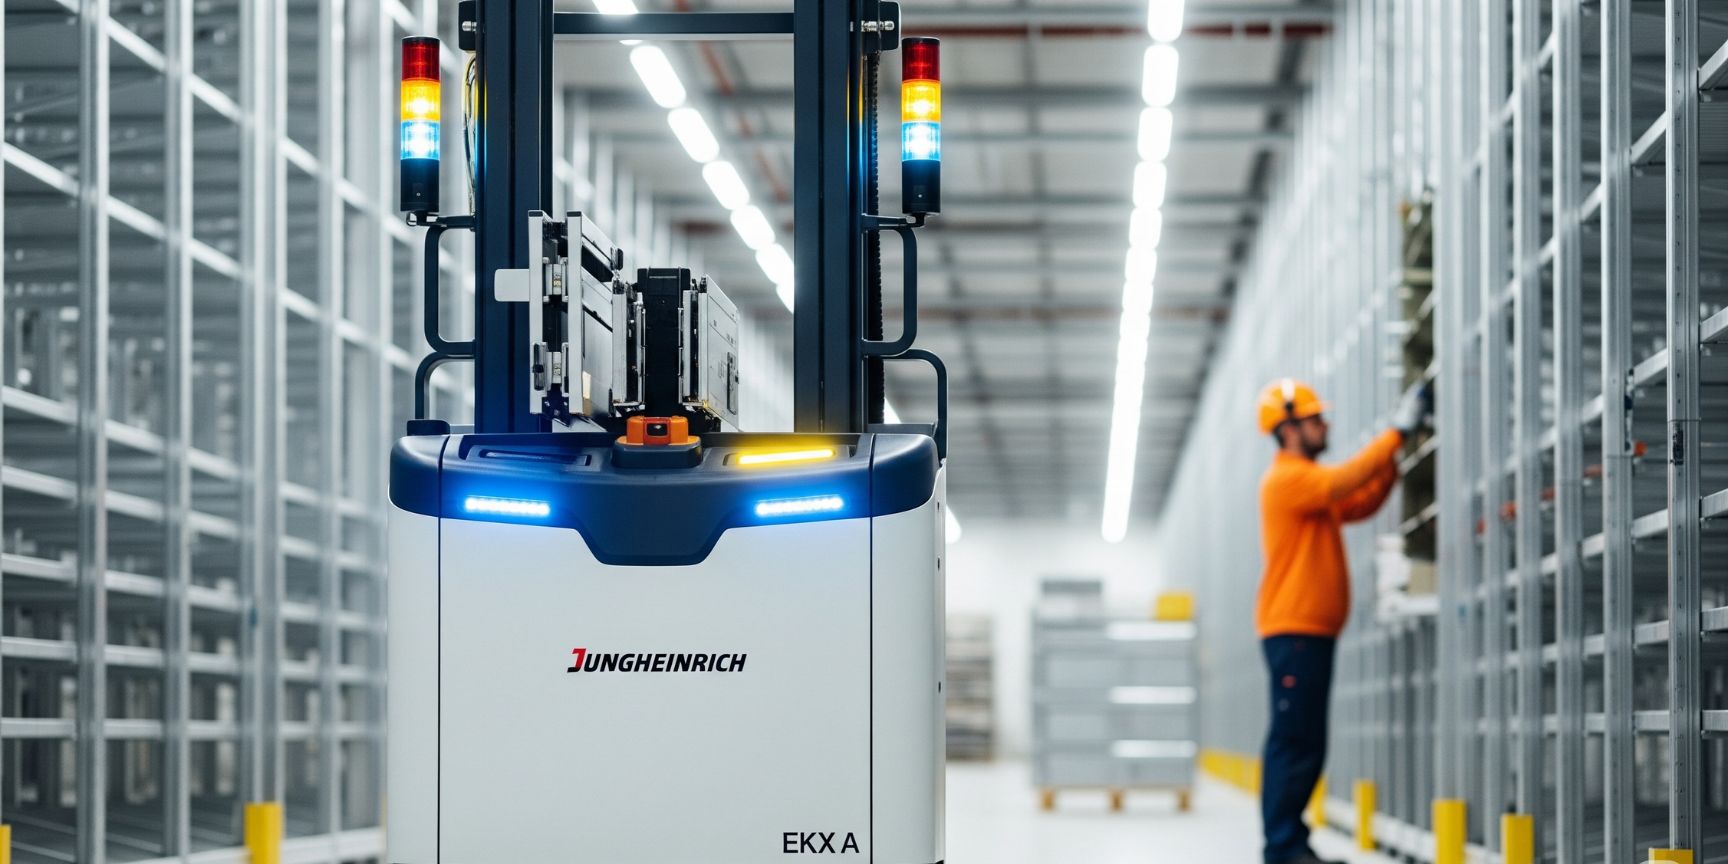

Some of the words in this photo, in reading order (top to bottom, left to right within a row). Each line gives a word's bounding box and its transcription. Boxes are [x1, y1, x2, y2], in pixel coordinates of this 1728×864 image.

[567, 648, 747, 673] JUNGHEINRICH
[783, 832, 836, 853] EKX
[841, 832, 860, 853] A
